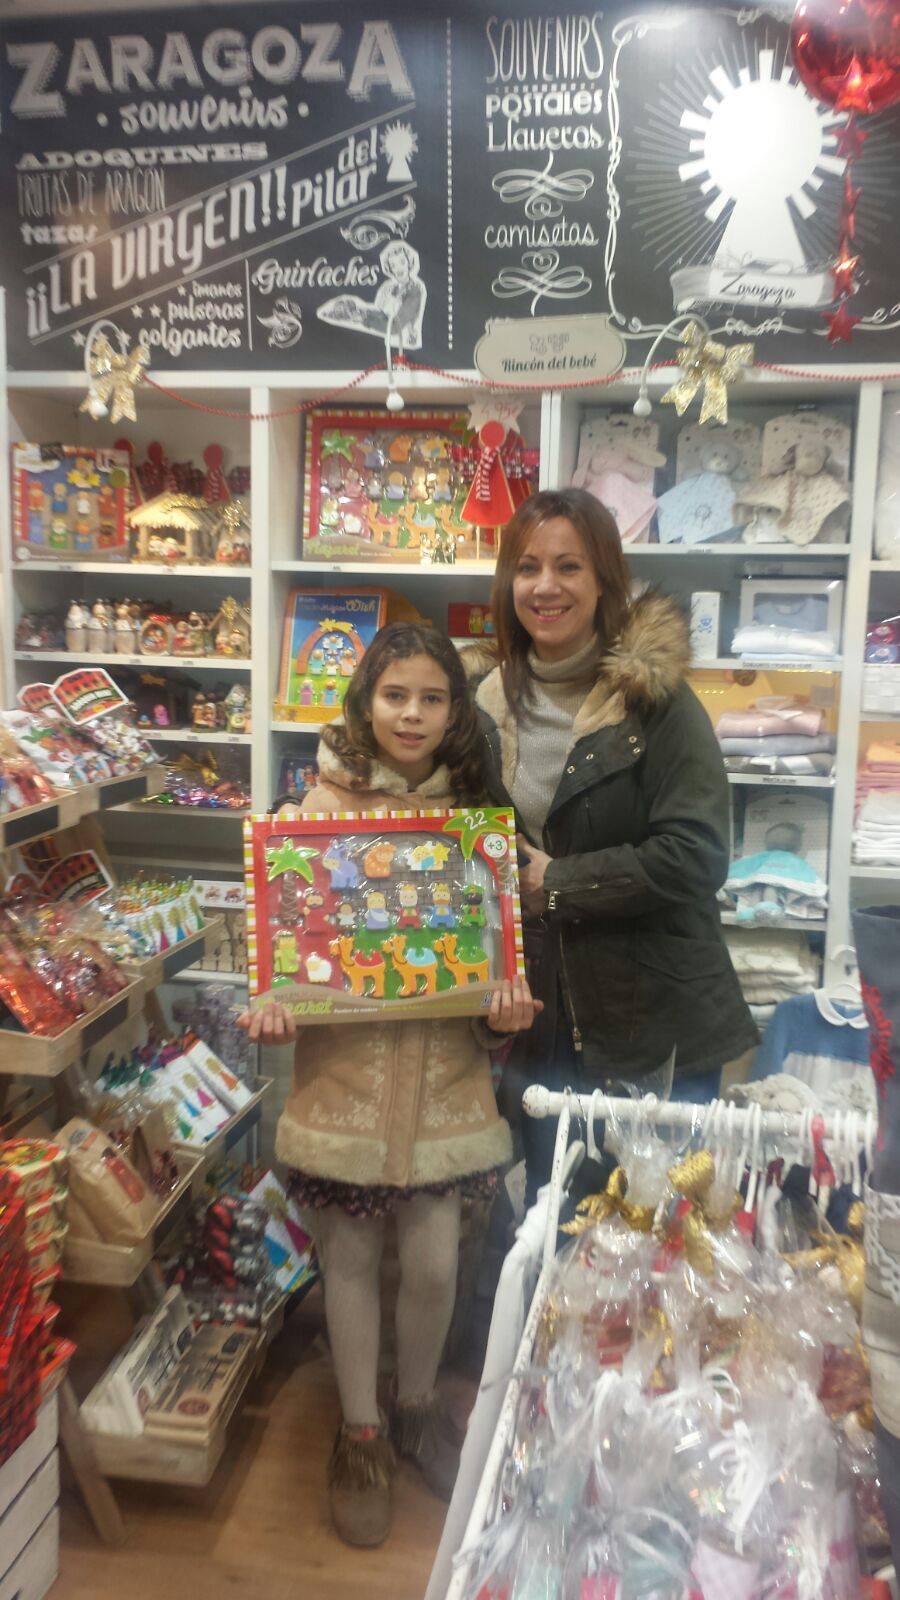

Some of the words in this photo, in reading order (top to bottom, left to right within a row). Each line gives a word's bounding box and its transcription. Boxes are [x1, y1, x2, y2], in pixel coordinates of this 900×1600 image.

[486, 12, 604, 83] SOUVENIRS
[6, 20, 417, 119] ZARAGOZA
[119, 86, 289, 136] souvenirs
[15, 142, 269, 170] ADOQUINES
[338, 126, 378, 174] del
[484, 218, 599, 250] camisetas
[252, 256, 380, 295] Guirlaches
[168, 296, 245, 324] pulseras
[138, 319, 241, 357] colgantes
[547, 355, 567, 370] del
[569, 353, 597, 369] bebé
[464, 811, 487, 830] 22
